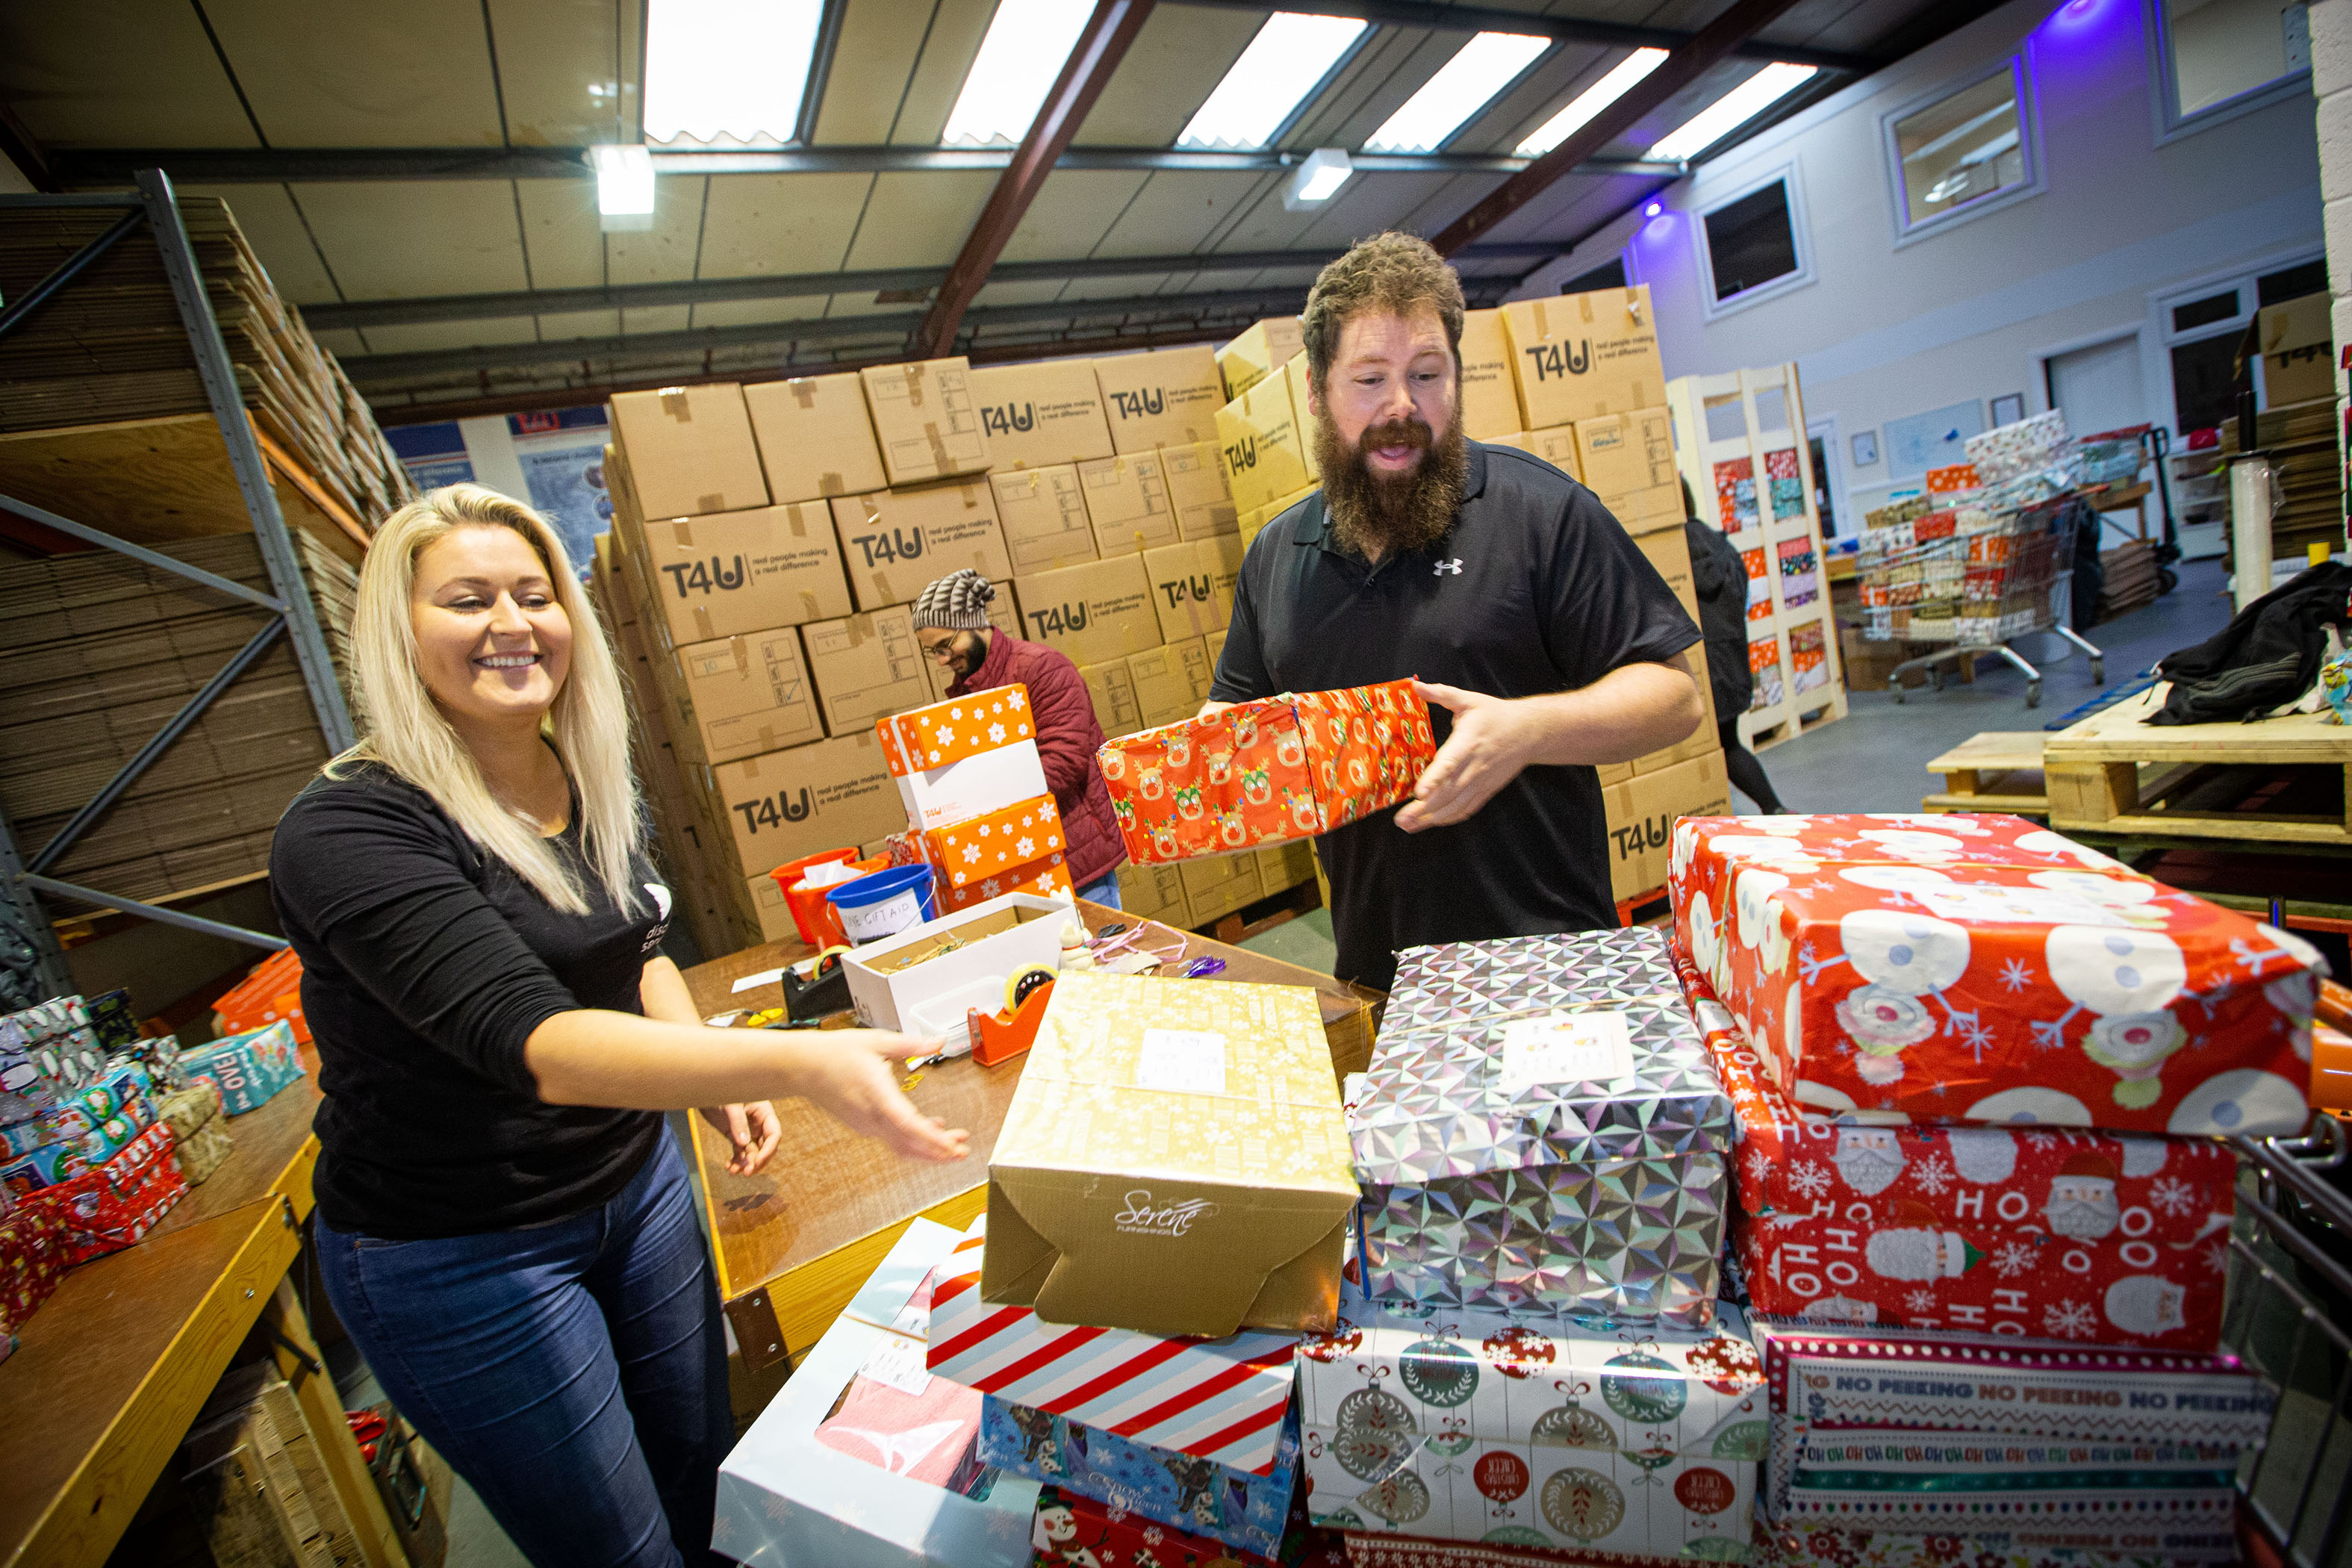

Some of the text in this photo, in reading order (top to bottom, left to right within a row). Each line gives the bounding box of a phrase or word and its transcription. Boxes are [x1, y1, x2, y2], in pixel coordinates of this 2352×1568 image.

[1525, 338, 1590, 382] T4U
[980, 401, 1035, 438] T4U
[1110, 387, 1164, 420] T4U
[1225, 435, 1256, 476] T4U
[752, 548, 828, 564] real people making
[851, 526, 924, 568] T4U
[662, 555, 744, 598] T4U
[762, 564, 778, 573] real
[780, 560, 819, 570] difference
[1028, 600, 1087, 639] T4U
[817, 772, 887, 795] real people making
[827, 794, 841, 803] real
[843, 784, 880, 799] difference
[732, 786, 810, 835] T4U
[1611, 813, 1668, 861] T4U
[865, 909, 886, 925] GIFT
[1115, 1189, 1210, 1237] Serene
[1955, 1189, 2029, 1222] HO
[1836, 1376, 1873, 1393] NO
[1879, 1378, 1973, 1399] PEEKING
[1979, 1384, 2016, 1401] NO
[2023, 1386, 2122, 1408] PEEKING
[2129, 1391, 2167, 1409] NO
